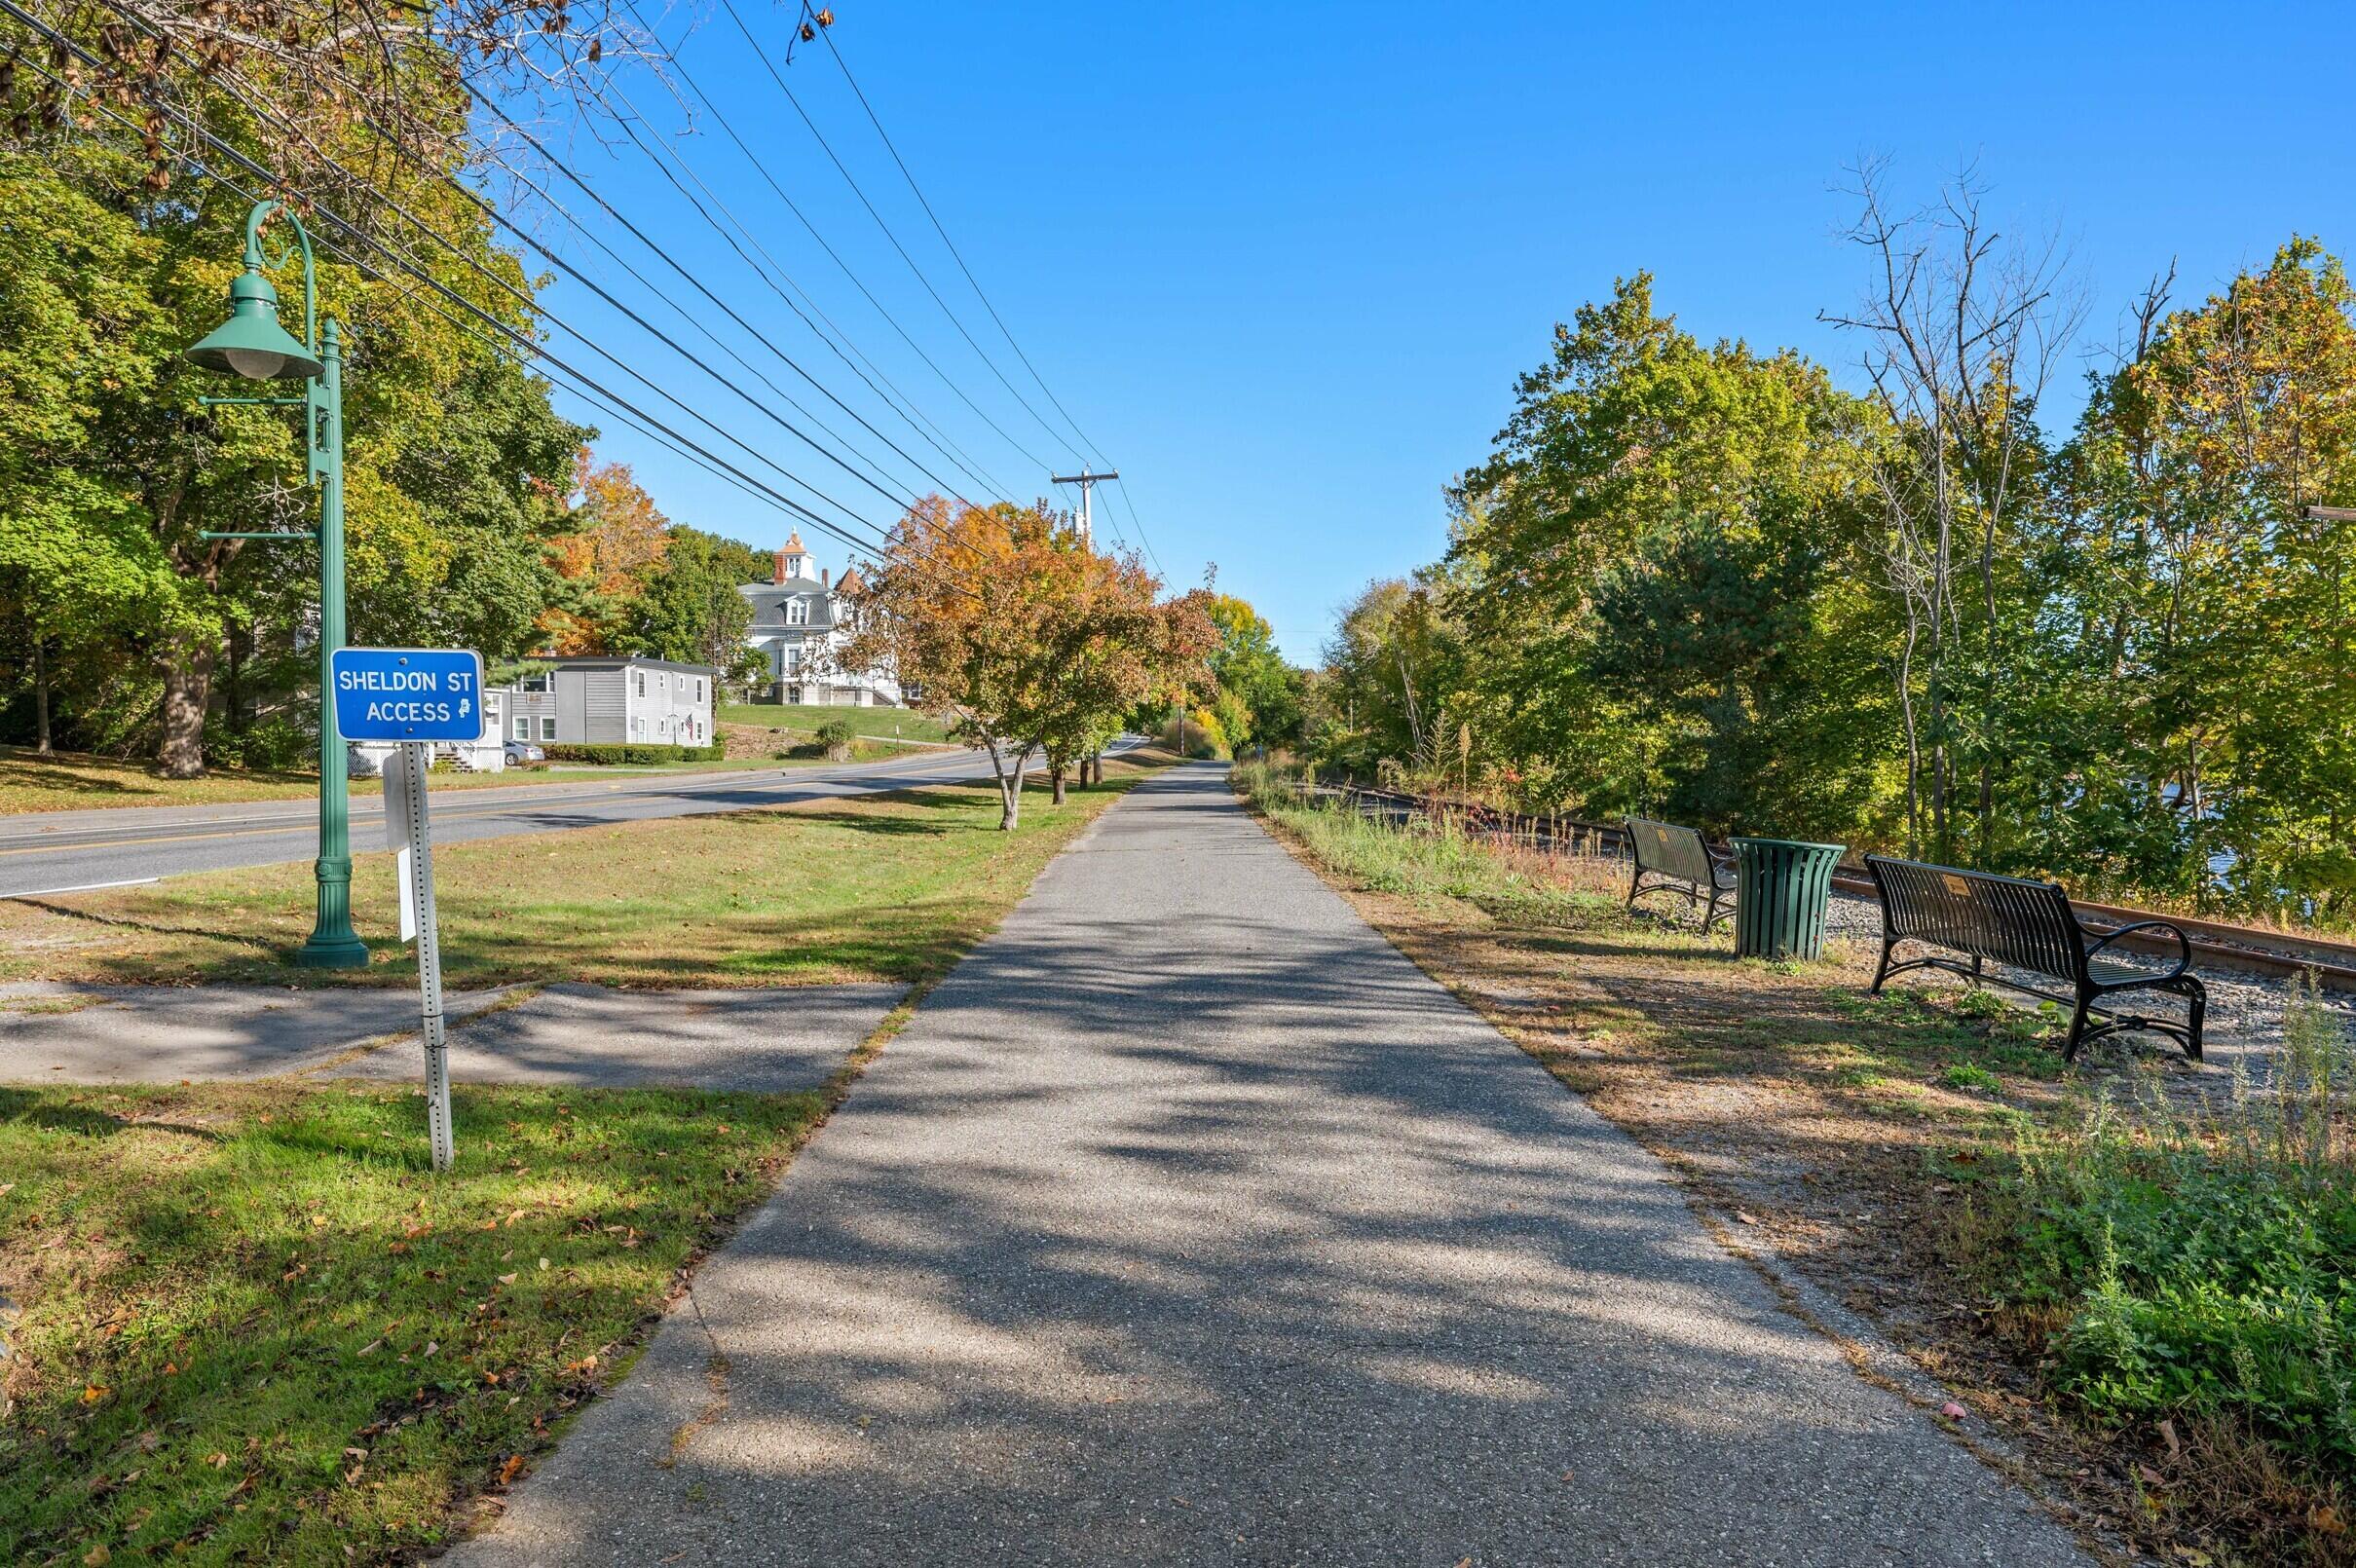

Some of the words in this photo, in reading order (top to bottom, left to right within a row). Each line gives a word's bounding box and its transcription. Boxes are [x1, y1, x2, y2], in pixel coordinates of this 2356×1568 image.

[340, 670, 436, 691] SHELDON
[447, 672, 472, 692] ST
[366, 702, 451, 722] ACCESS
